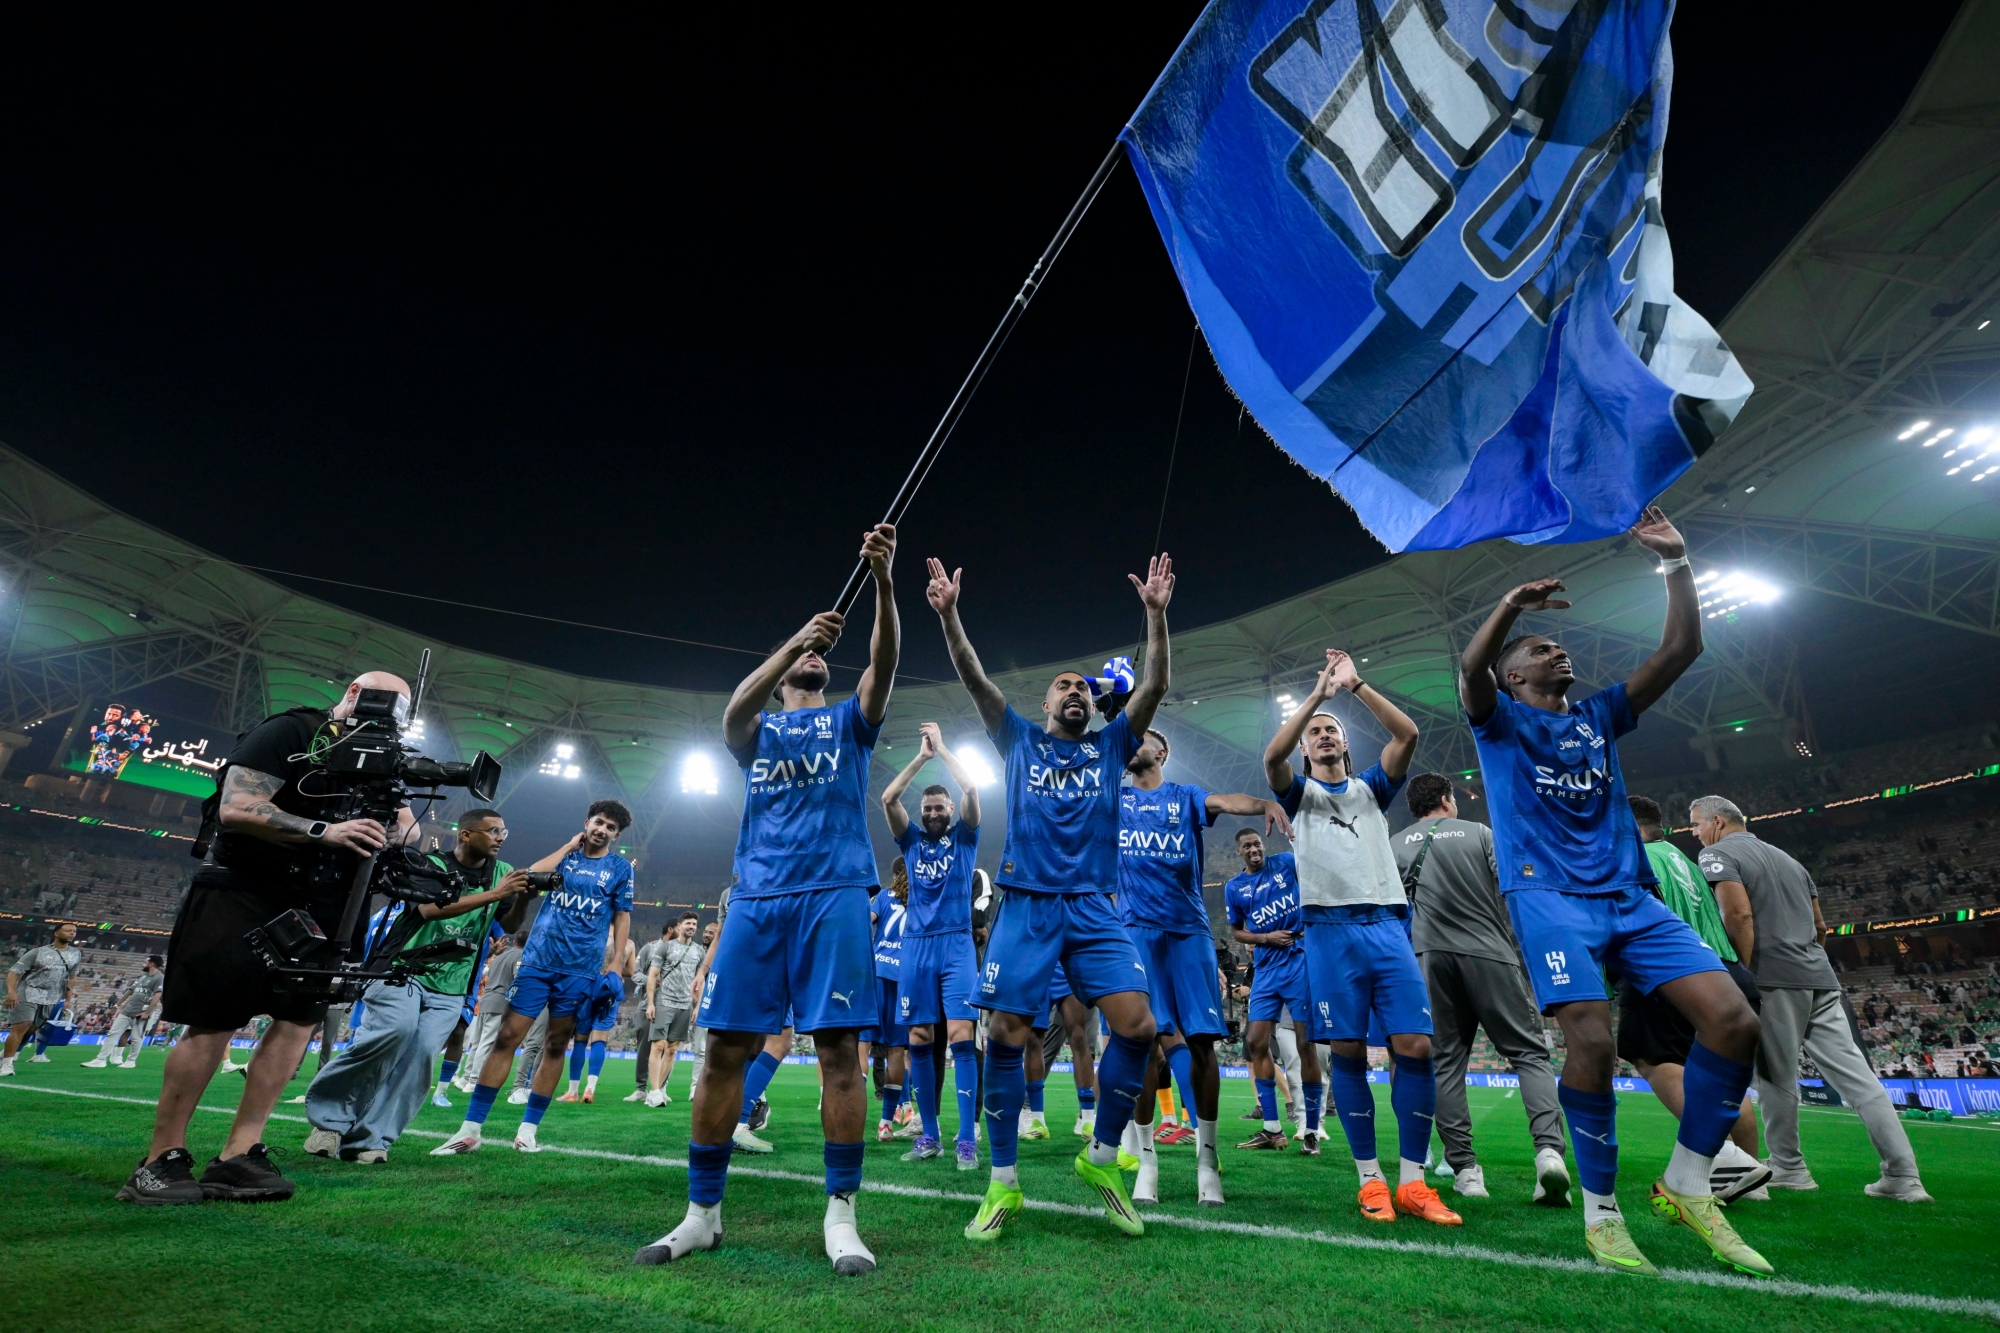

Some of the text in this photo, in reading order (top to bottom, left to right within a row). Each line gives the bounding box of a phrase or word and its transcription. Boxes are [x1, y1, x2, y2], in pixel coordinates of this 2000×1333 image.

[181, 738, 208, 756] إلى
[1560, 739, 1582, 750] jahe
[142, 742, 227, 773] لنهائي
[1029, 765, 1101, 790] SAVVY
[1536, 786, 1586, 799] GAMES
[1119, 829, 1184, 851] SAVVY
[1252, 893, 1295, 924] SAVVY
[445, 925, 473, 936] SAFF
[875, 953, 900, 966] YSEVE
[1487, 1075, 1520, 1087] kinz
[1884, 1082, 1906, 1105] inza
[1919, 1081, 1953, 1111] inza
